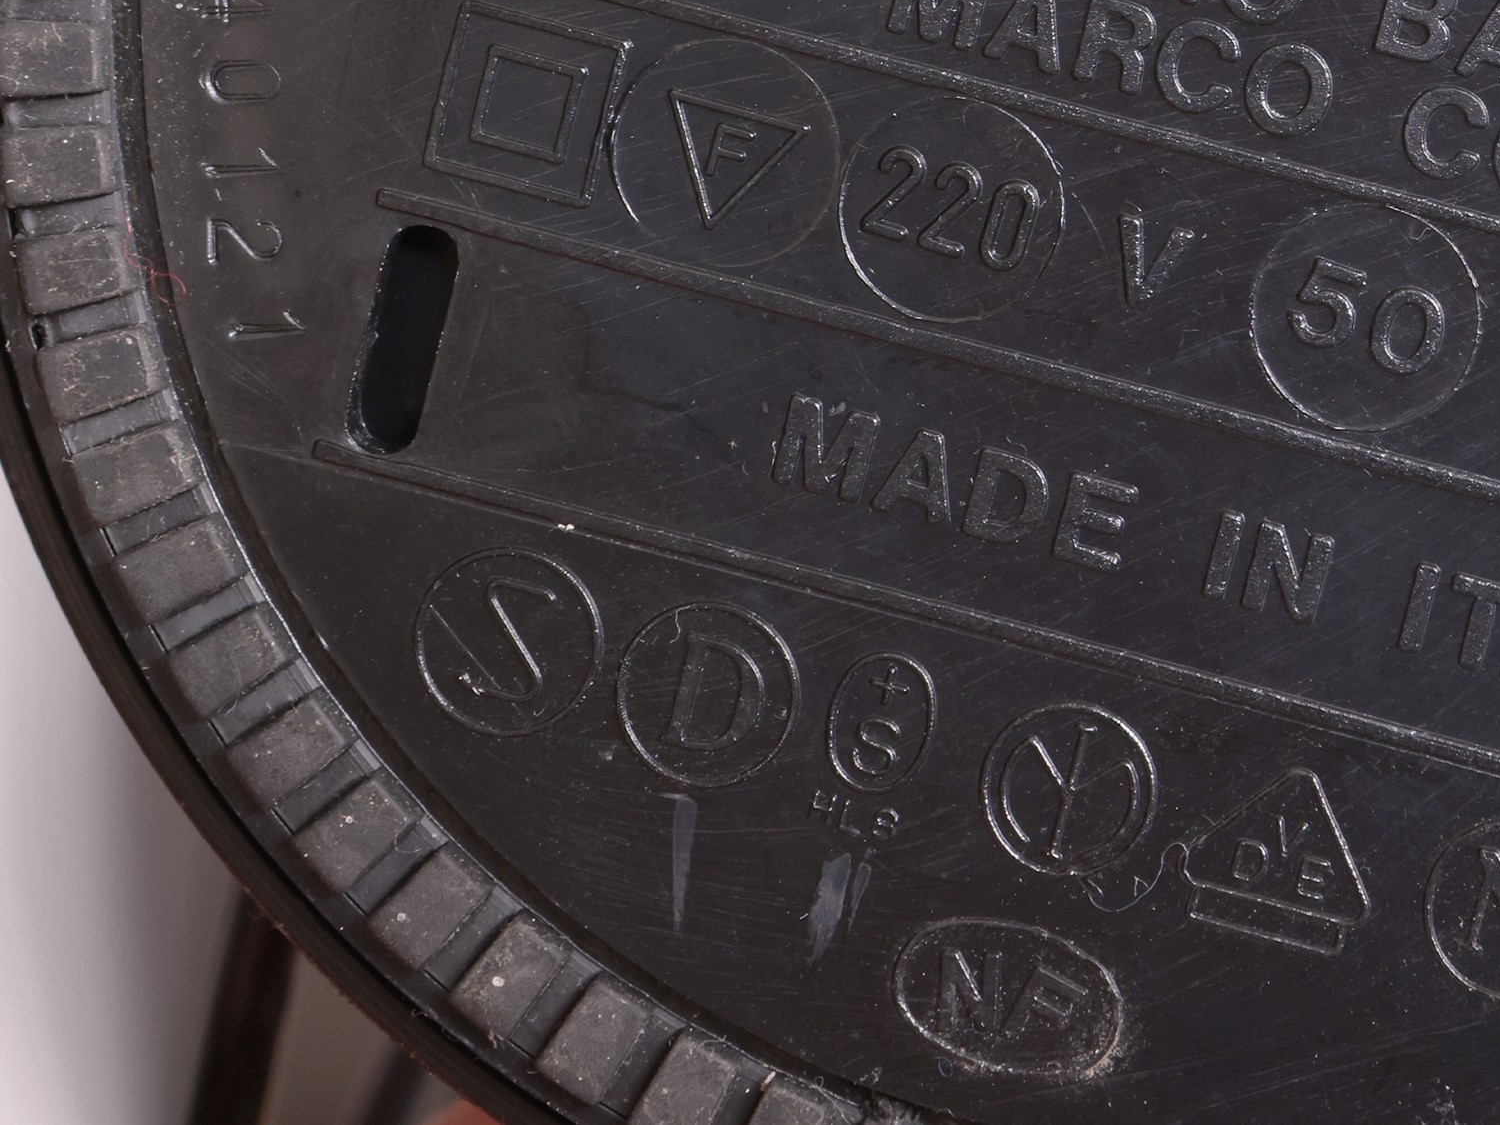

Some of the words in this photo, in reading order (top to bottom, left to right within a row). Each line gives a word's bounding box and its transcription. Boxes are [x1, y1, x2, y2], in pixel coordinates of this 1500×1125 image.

[858, 144, 1041, 273] 220
[1117, 211, 1195, 311] V
[1285, 255, 1446, 376] 50
[770, 392, 1140, 571] MADE
[1200, 509, 1337, 626] IN
